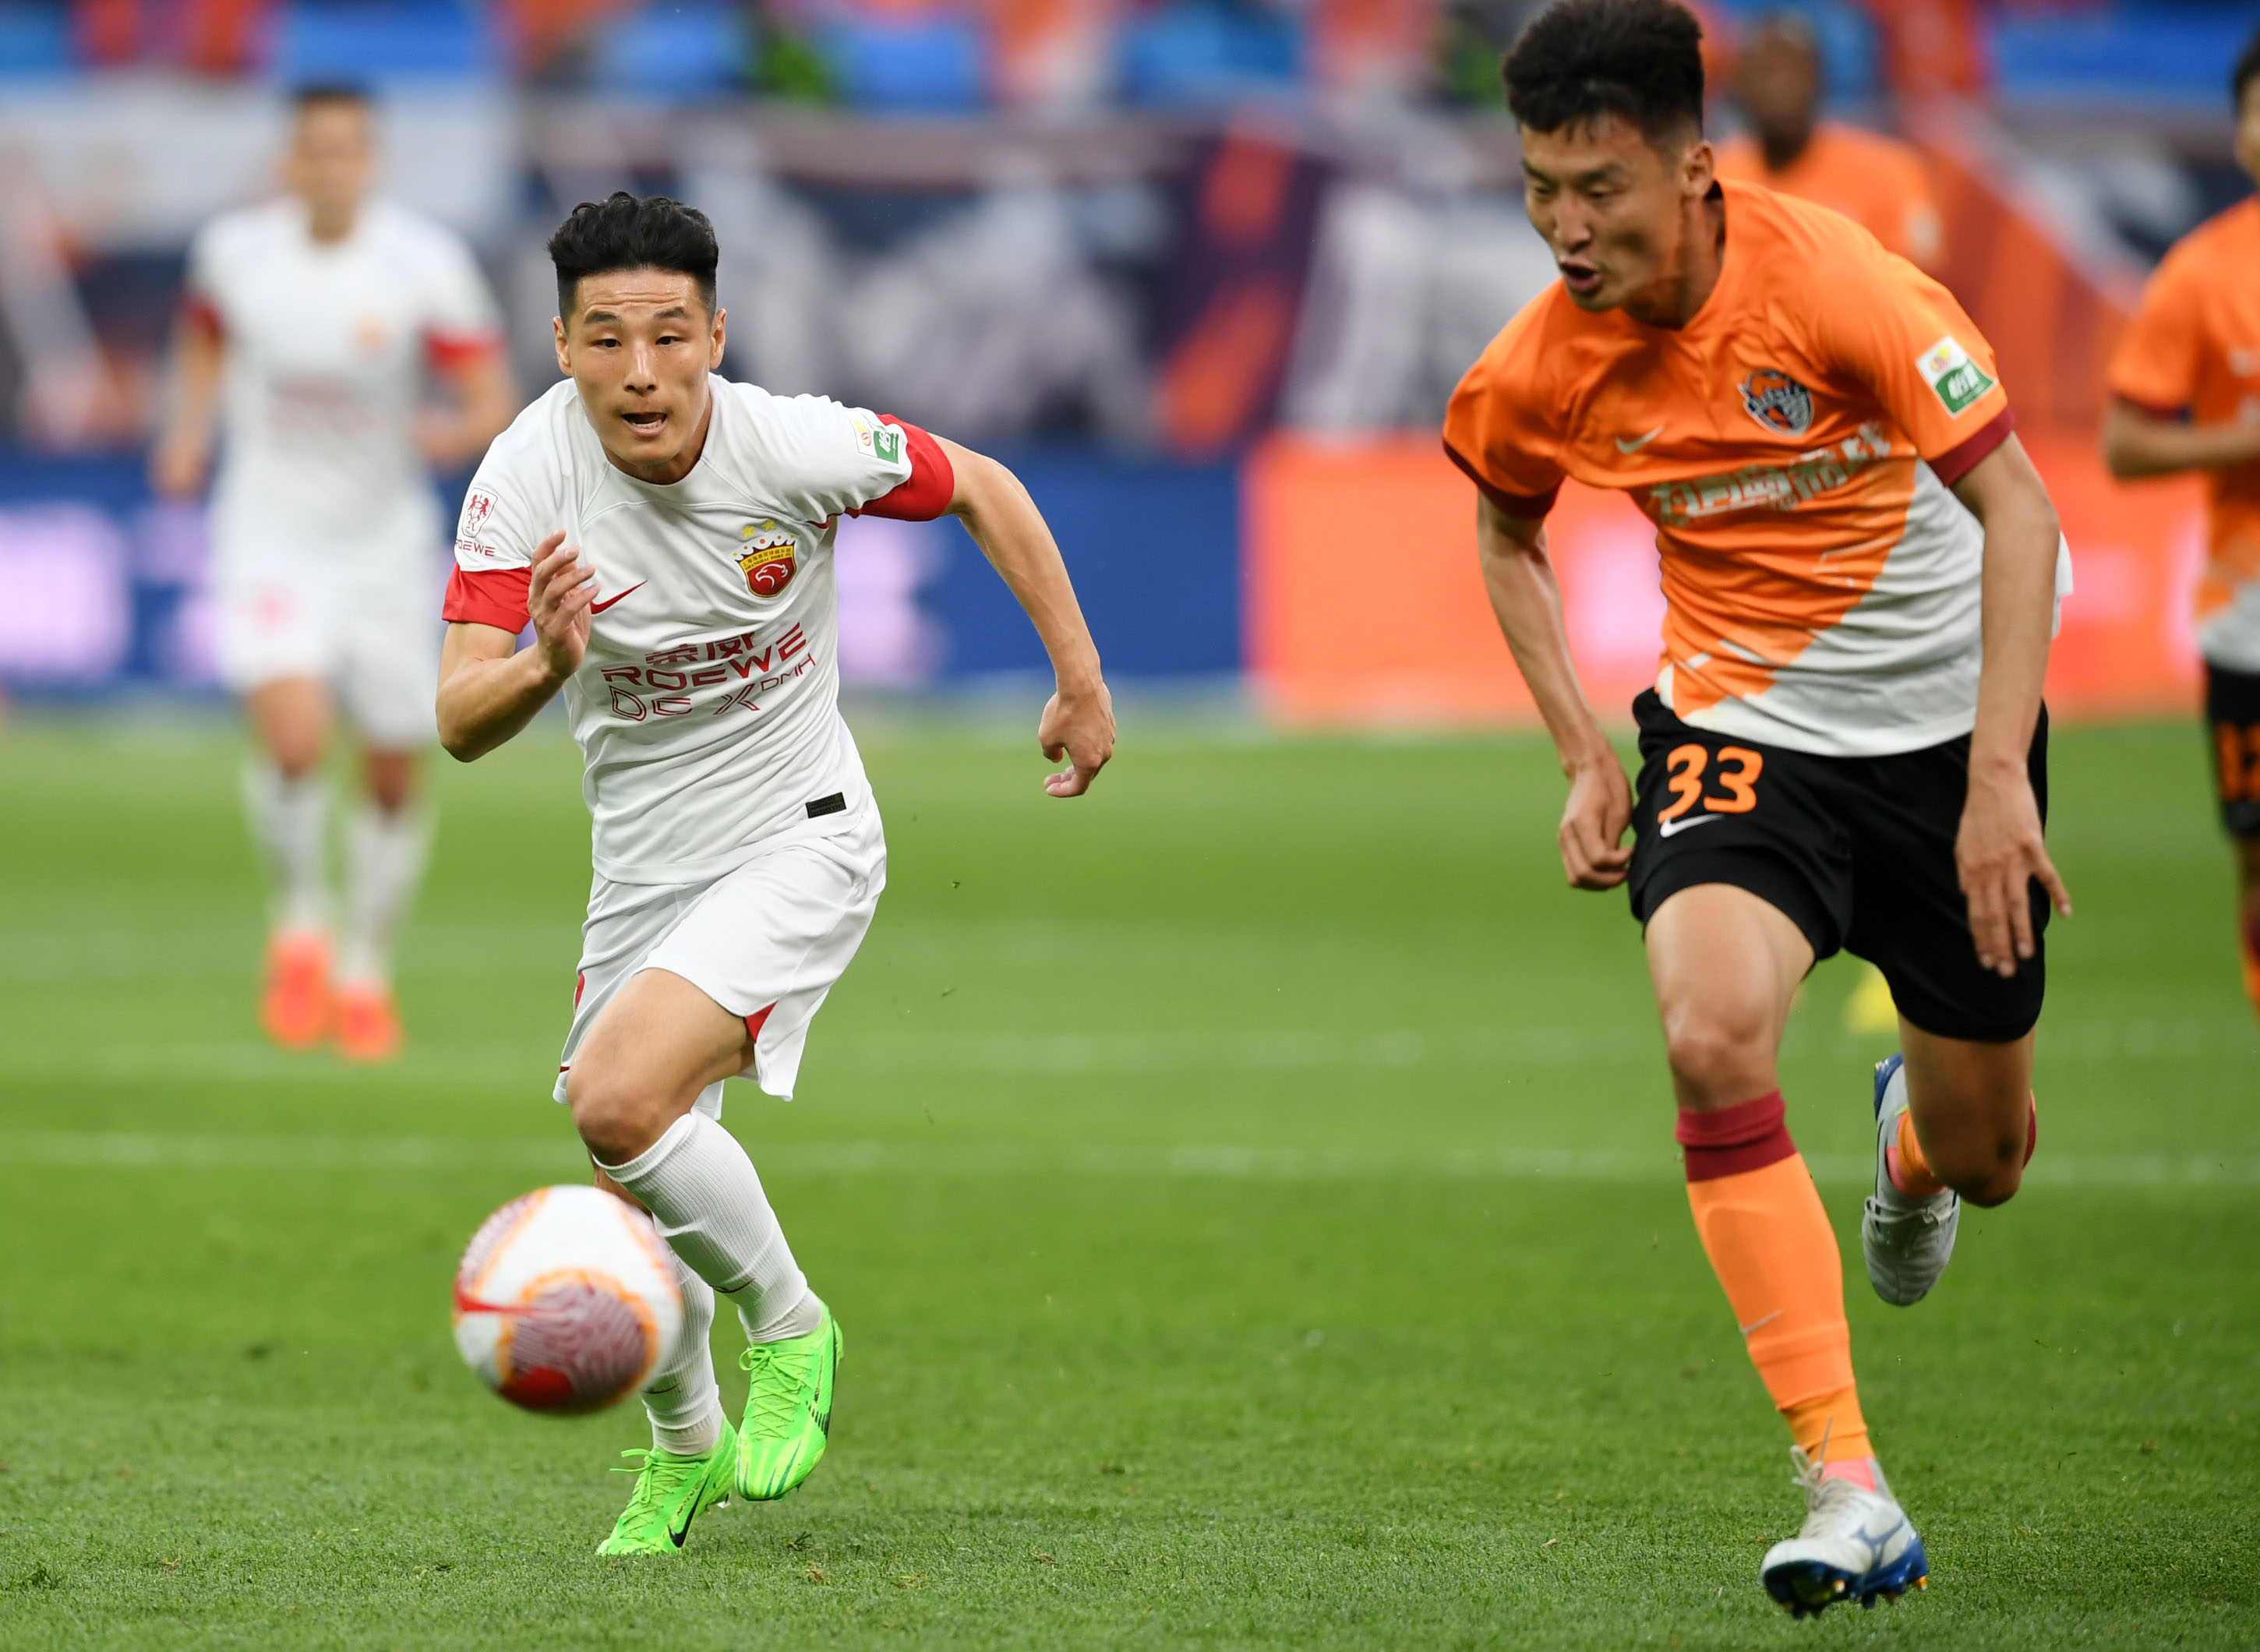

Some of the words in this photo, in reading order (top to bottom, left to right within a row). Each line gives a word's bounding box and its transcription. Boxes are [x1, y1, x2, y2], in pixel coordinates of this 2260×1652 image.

[455, 539, 496, 556] OEWE
[602, 622, 807, 691] ROEWE
[761, 653, 816, 691] DMH
[1658, 743, 1763, 824] 33
